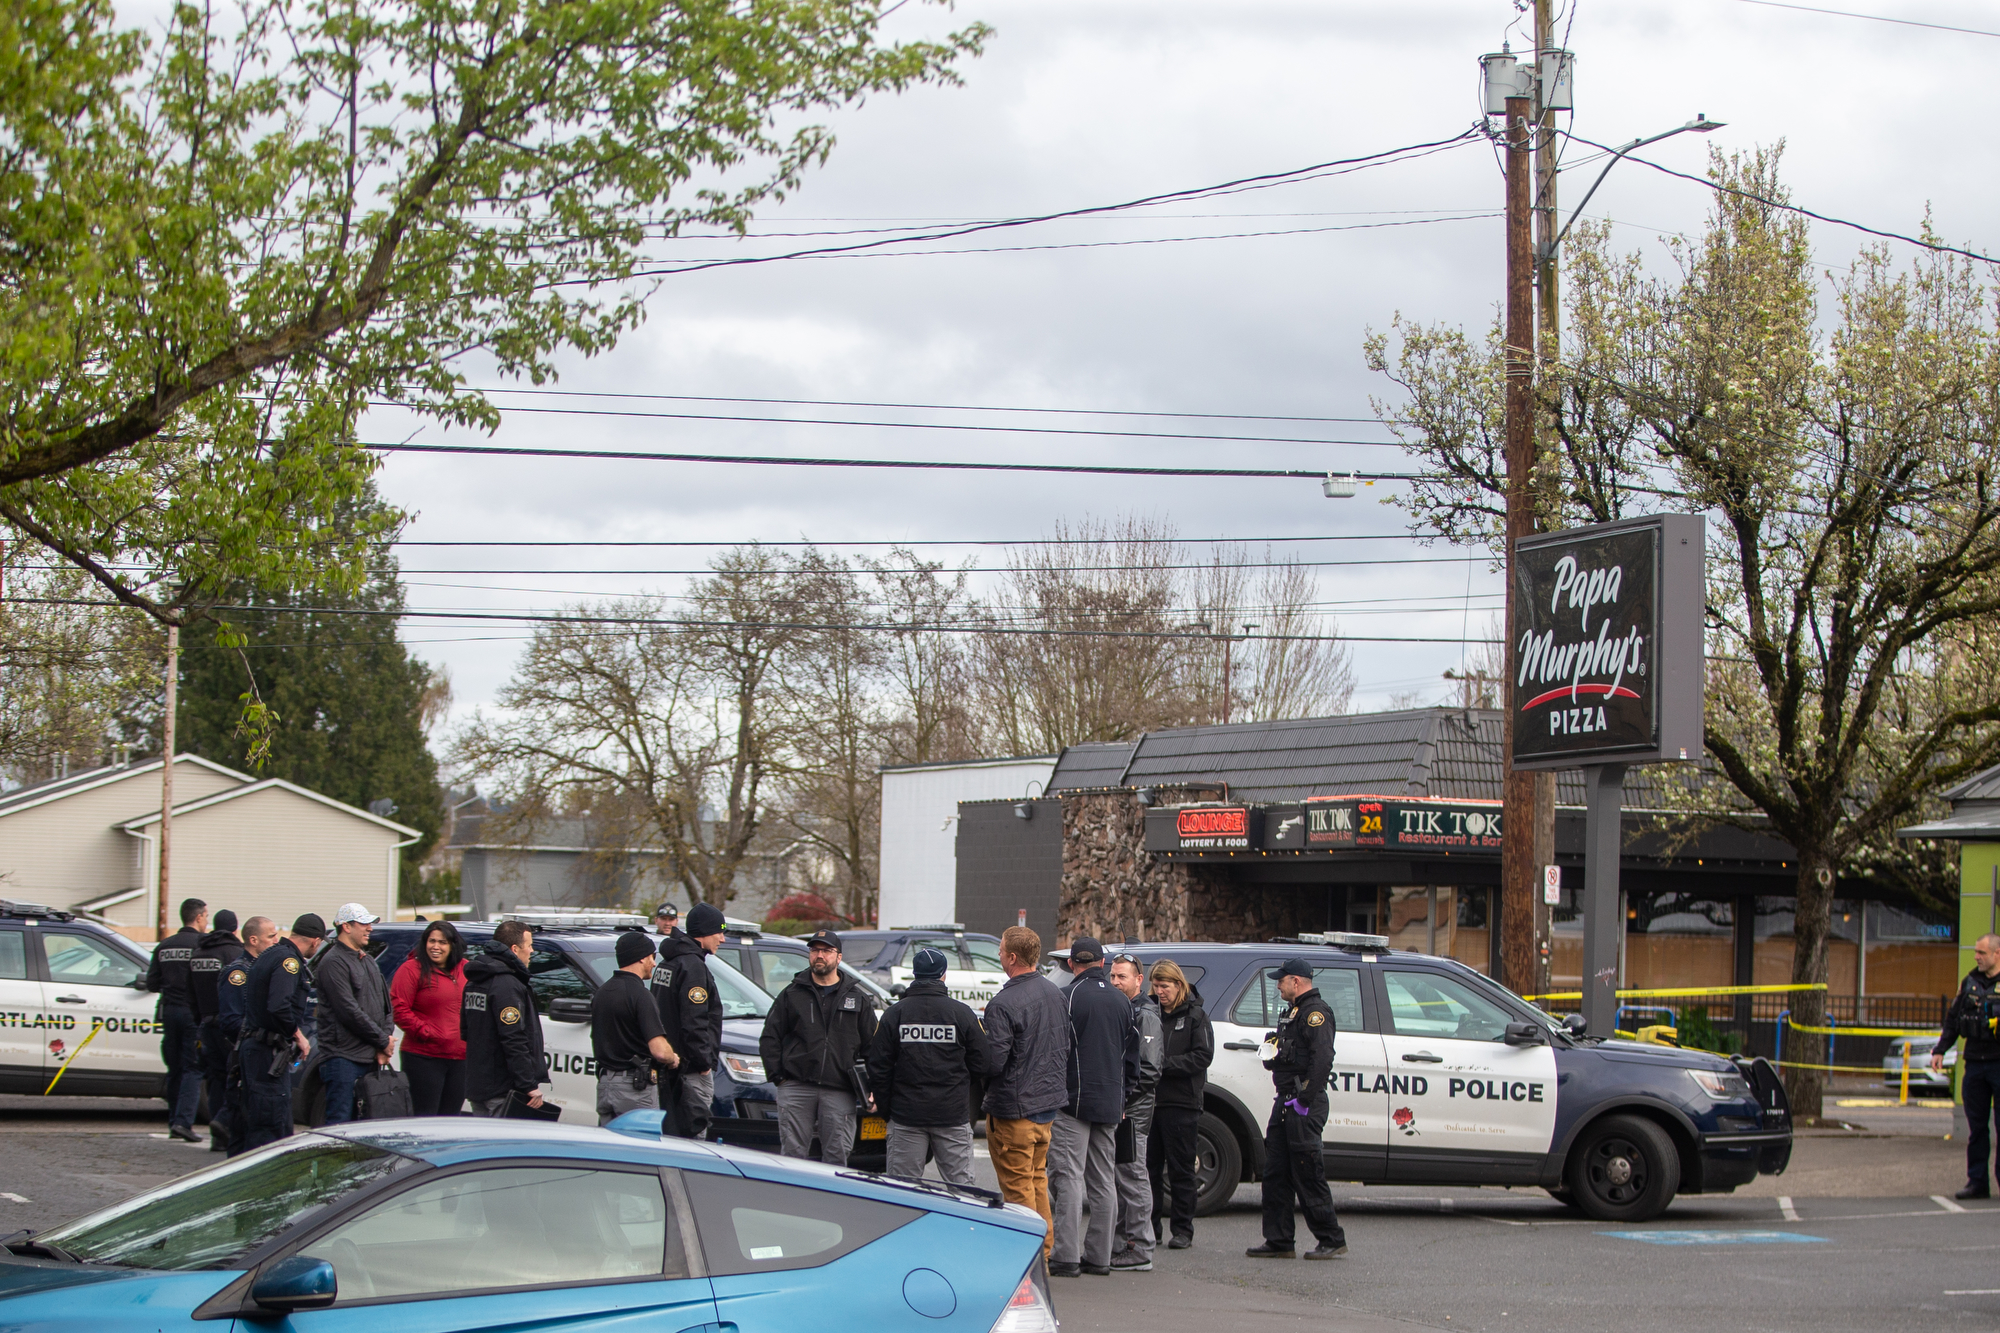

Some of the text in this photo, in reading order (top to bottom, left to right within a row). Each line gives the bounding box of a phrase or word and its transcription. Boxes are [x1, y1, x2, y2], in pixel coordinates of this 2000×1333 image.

[1551, 555, 1622, 633] Papa
[1518, 618, 1644, 705] Murphy's
[1550, 706, 1607, 736] PIZZA
[1181, 812, 1242, 832] LOUNGE
[1309, 809, 1328, 831] TIK
[1359, 815, 1383, 833] 24
[1400, 809, 1443, 833] TIK
[1180, 838, 1248, 848] LOTTERY & FOOD
[1398, 831, 1503, 847] Restaurant & Bar
[160, 950, 191, 960] POLICE
[192, 959, 221, 970] POLICE
[91, 1016, 165, 1034] POLICE
[901, 1027, 953, 1041] POLICE
[1449, 1078, 1544, 1102] POLICE
[1343, 1118, 1367, 1126] Protect
[1444, 1122, 1477, 1132] Dedicated
[1488, 1126, 1506, 1134] Serve
